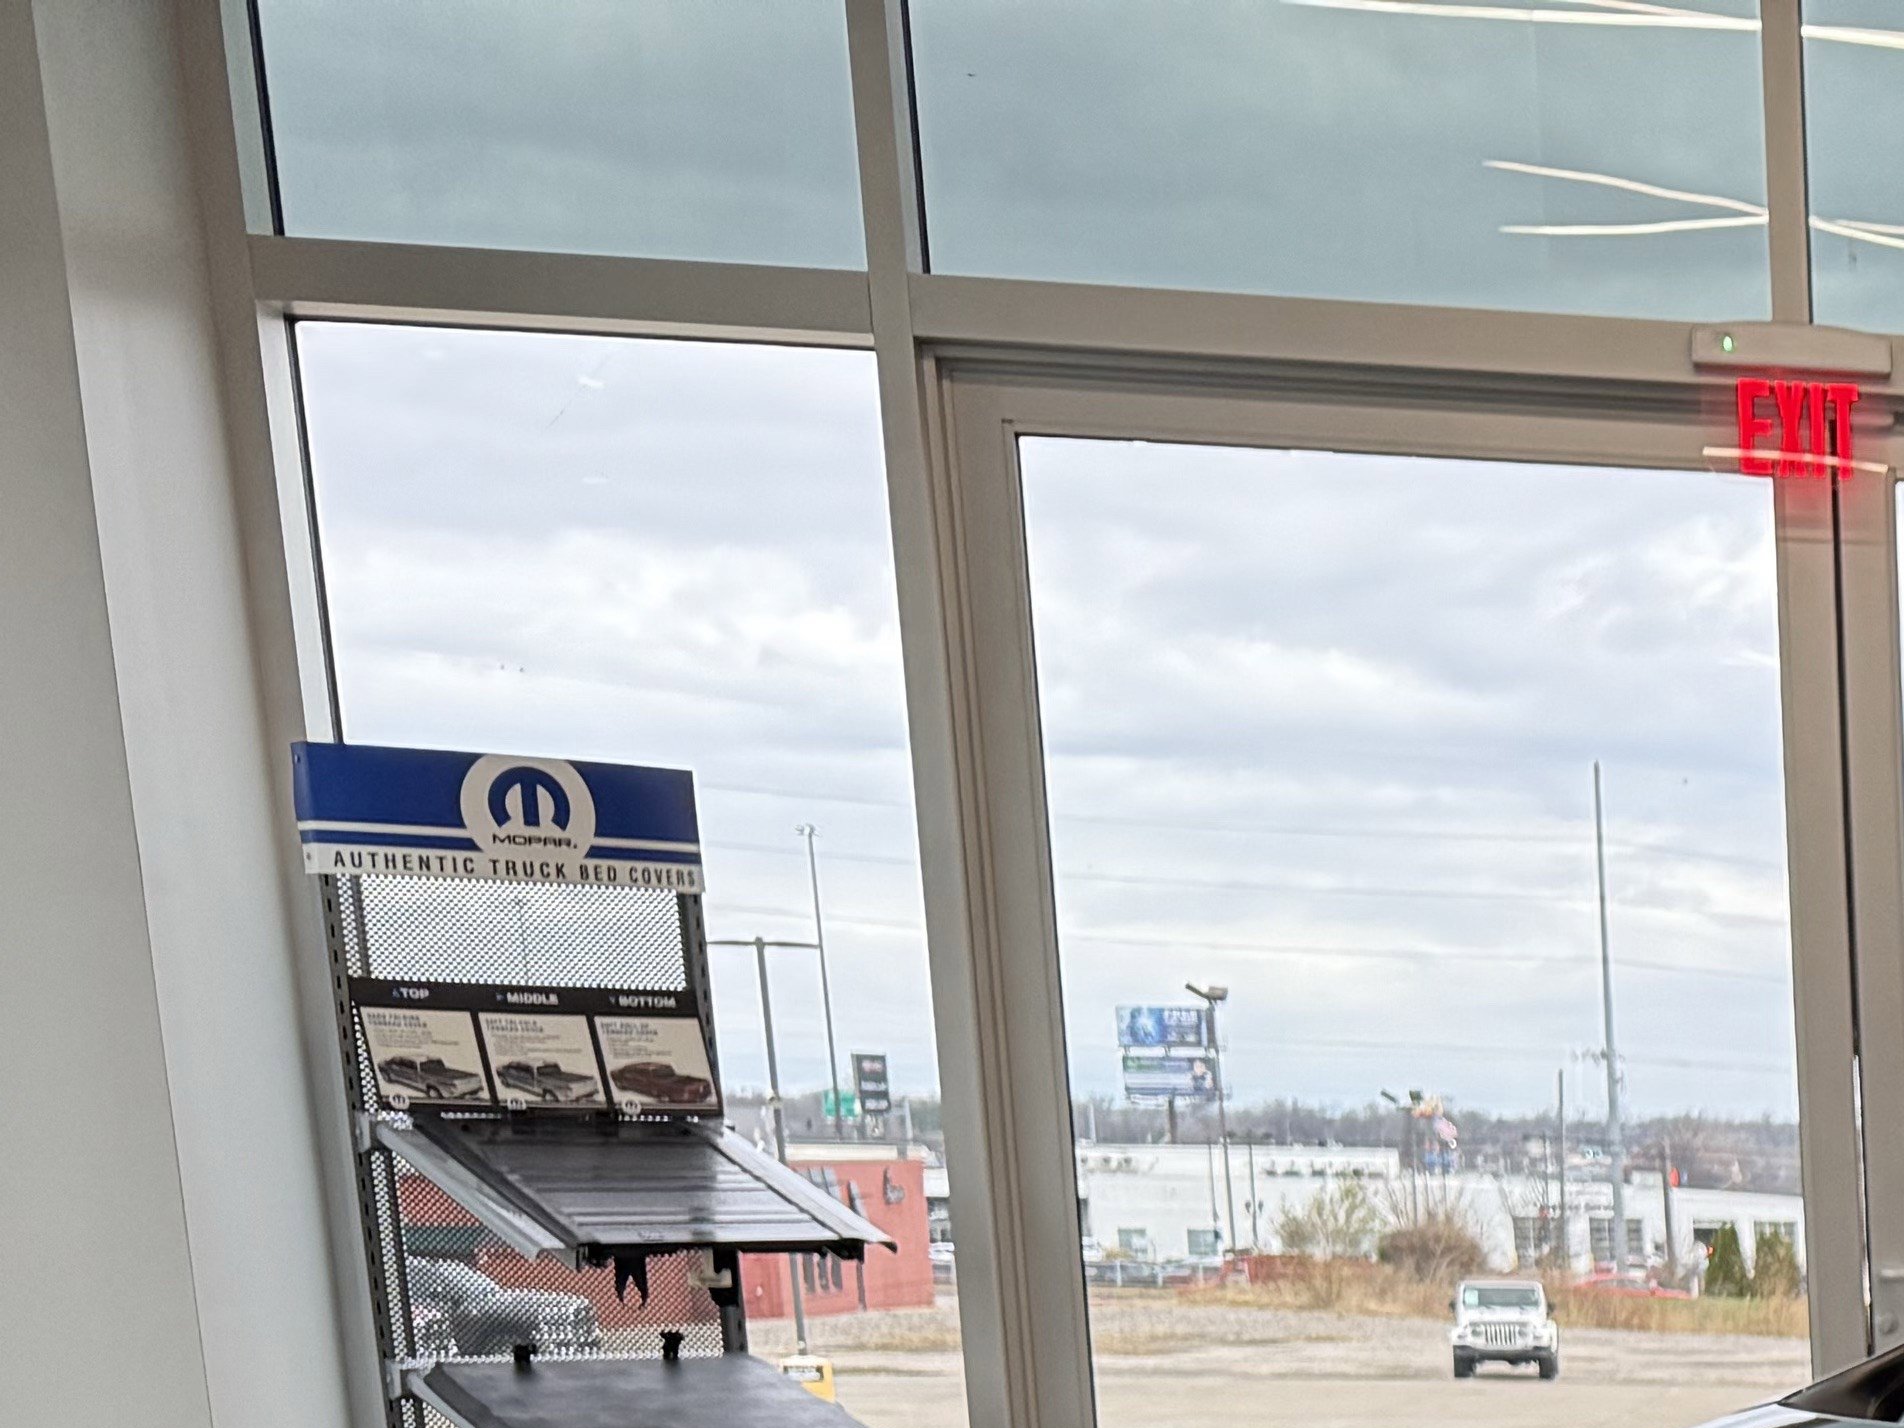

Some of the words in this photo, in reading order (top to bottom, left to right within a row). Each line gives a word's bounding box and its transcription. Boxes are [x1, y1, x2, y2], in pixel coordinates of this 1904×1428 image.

[1737, 378, 1859, 480] EXIT
[334, 850, 475, 875] AUTHENTIC
[490, 859, 567, 881] TRUCK
[580, 861, 617, 883] BED
[629, 864, 695, 887] COVERS
[400, 988, 430, 999] TOP
[507, 992, 559, 1006] MIDDLE
[618, 996, 677, 1008] BOTTOM
